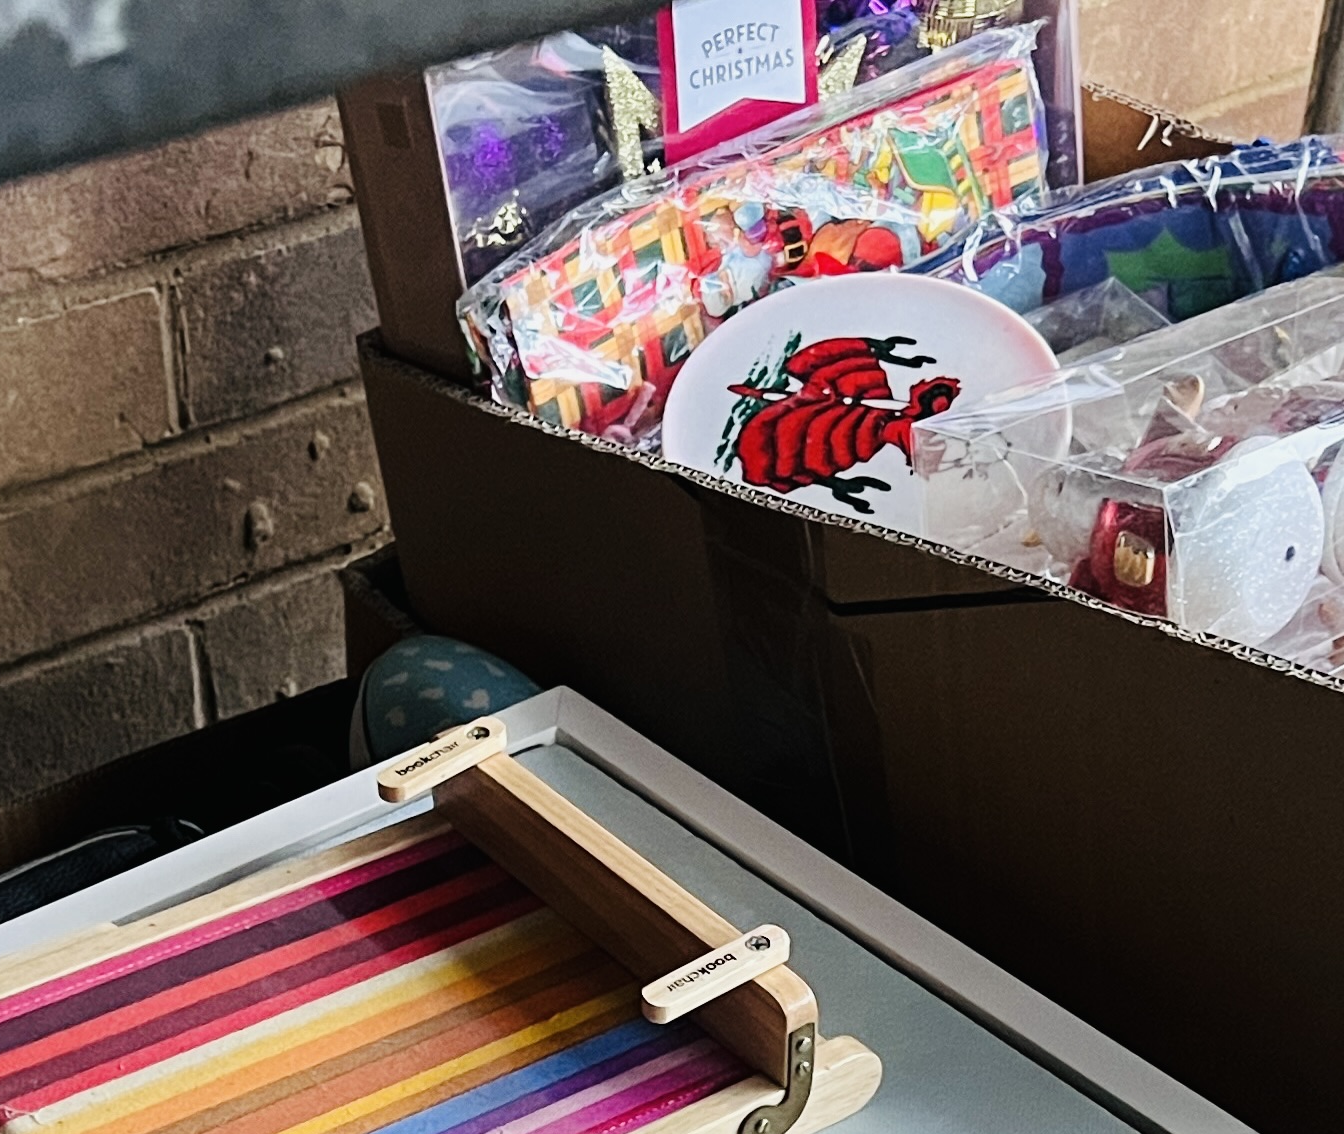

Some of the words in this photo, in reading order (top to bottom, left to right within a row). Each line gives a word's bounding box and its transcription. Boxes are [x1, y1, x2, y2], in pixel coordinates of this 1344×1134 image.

[701, 22, 780, 58] PERFECT
[689, 48, 795, 89] CHRISTMAS
[394, 741, 459, 776] bookchair
[666, 953, 737, 992] bookchair
